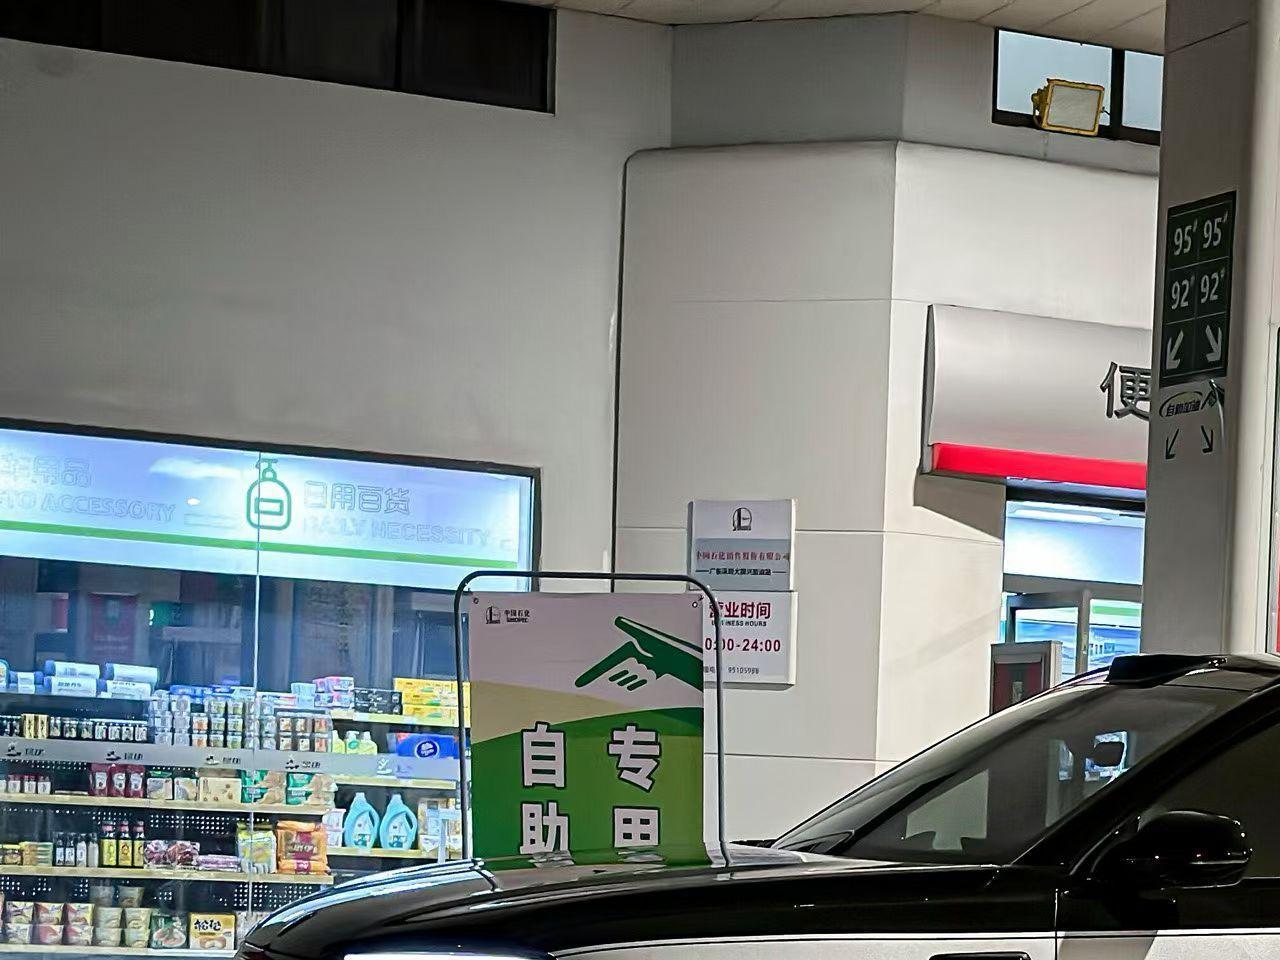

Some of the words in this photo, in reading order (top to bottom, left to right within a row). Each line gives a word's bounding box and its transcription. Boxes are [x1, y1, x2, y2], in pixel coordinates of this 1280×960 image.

[304, 479, 410, 515] 日用百货
[520, 722, 569, 854] 自助
